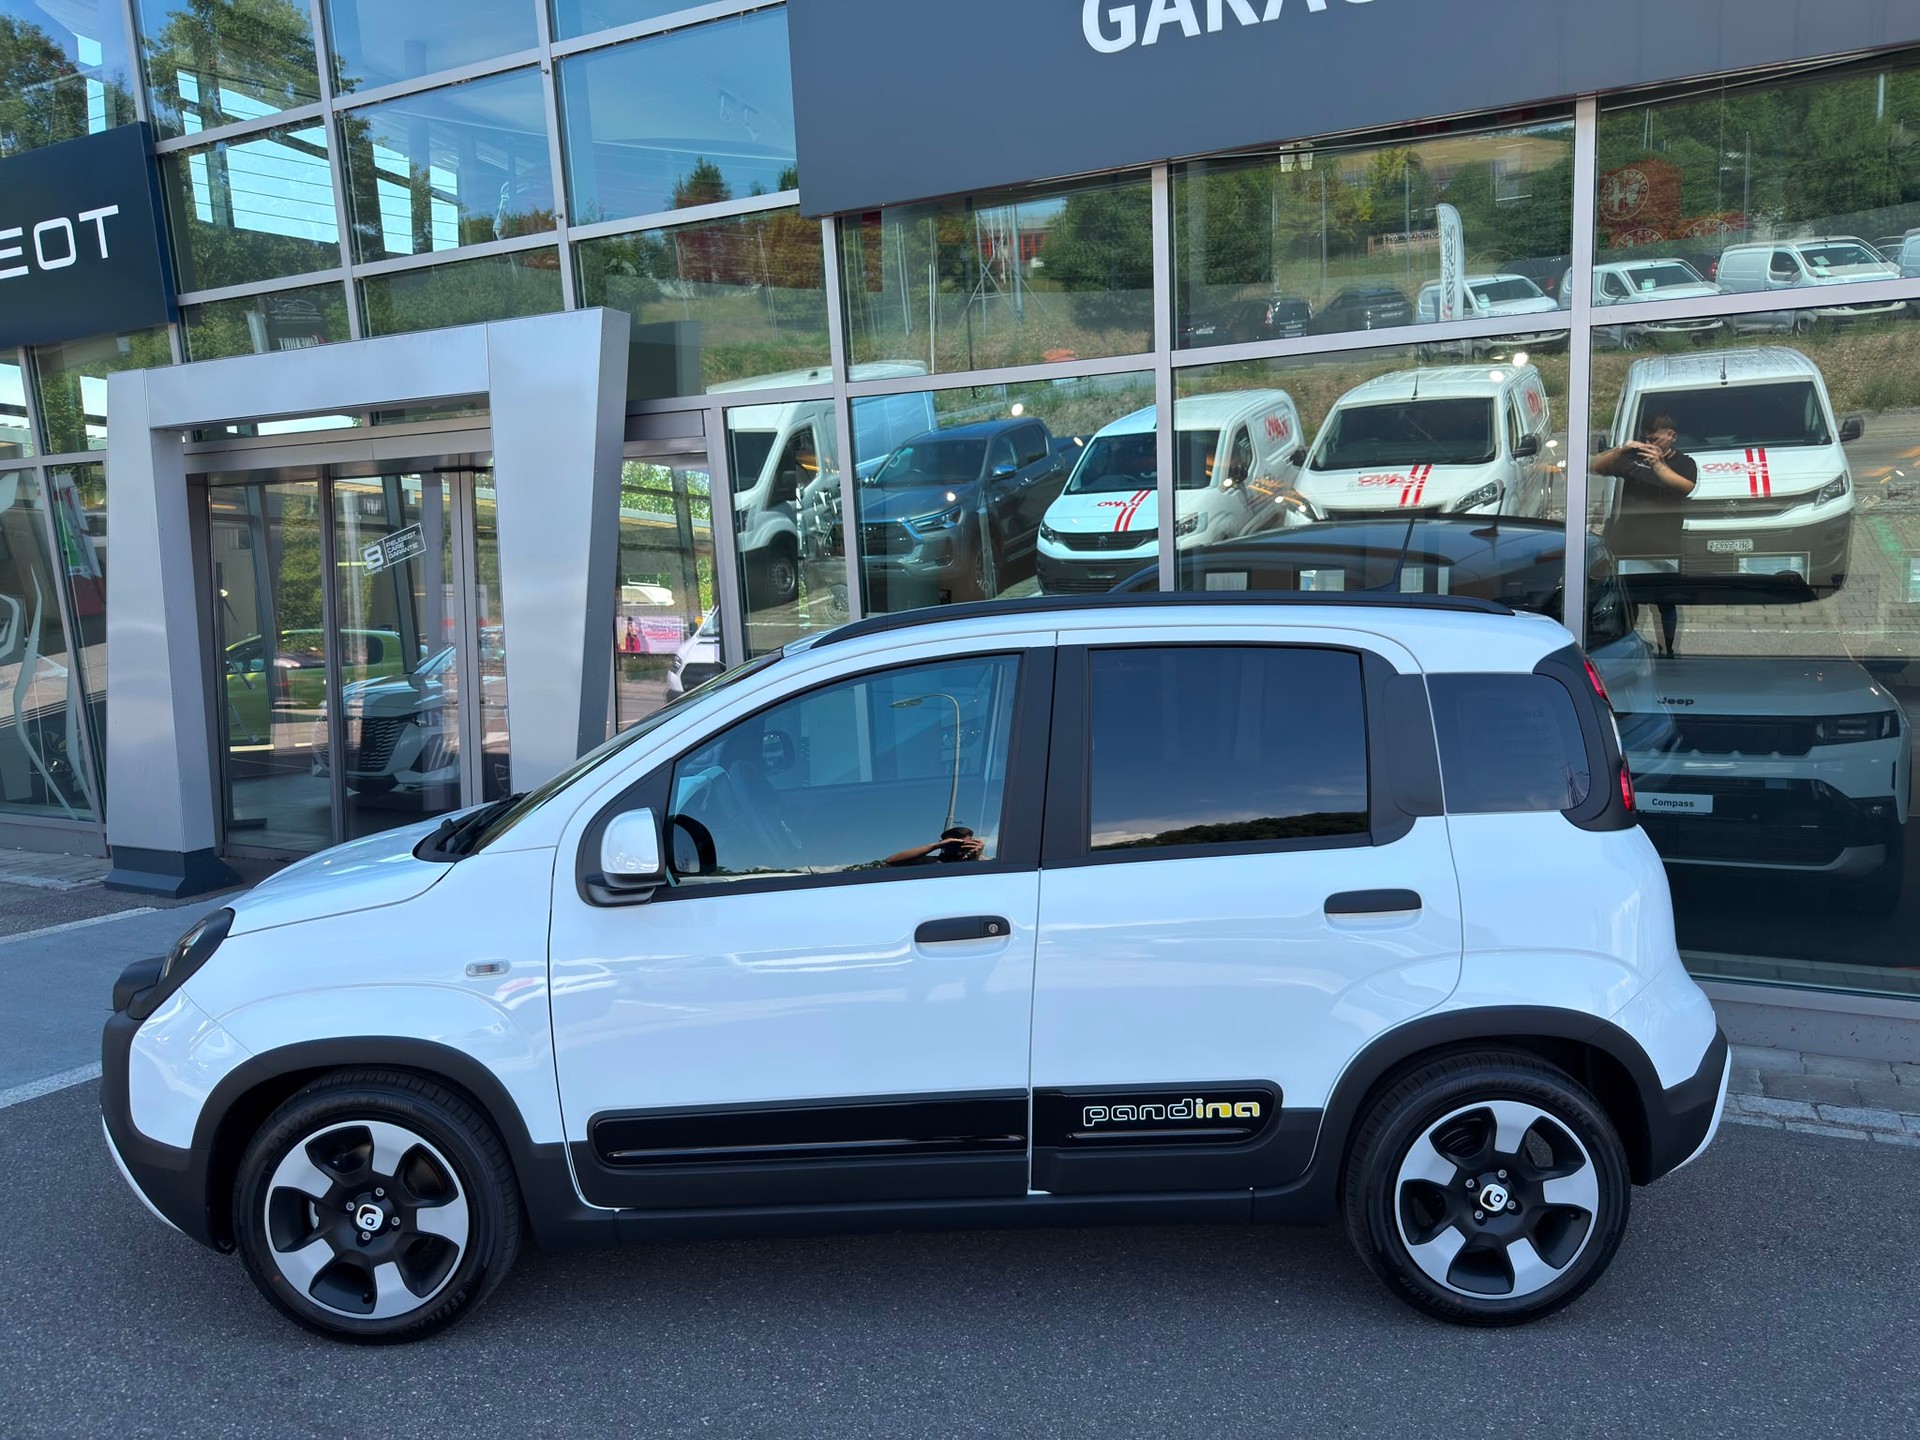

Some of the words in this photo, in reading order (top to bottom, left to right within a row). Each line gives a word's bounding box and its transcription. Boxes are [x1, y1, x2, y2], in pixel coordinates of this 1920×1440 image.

[386, 531, 416, 548] PEUGEOT
[387, 542, 405, 554] CARE
[363, 545, 384, 570] 8
[388, 541, 419, 559] GARANTIE
[1657, 697, 1695, 707] Jeep
[1651, 798, 1695, 808] Compass
[1083, 1098, 1261, 1127] pandina
